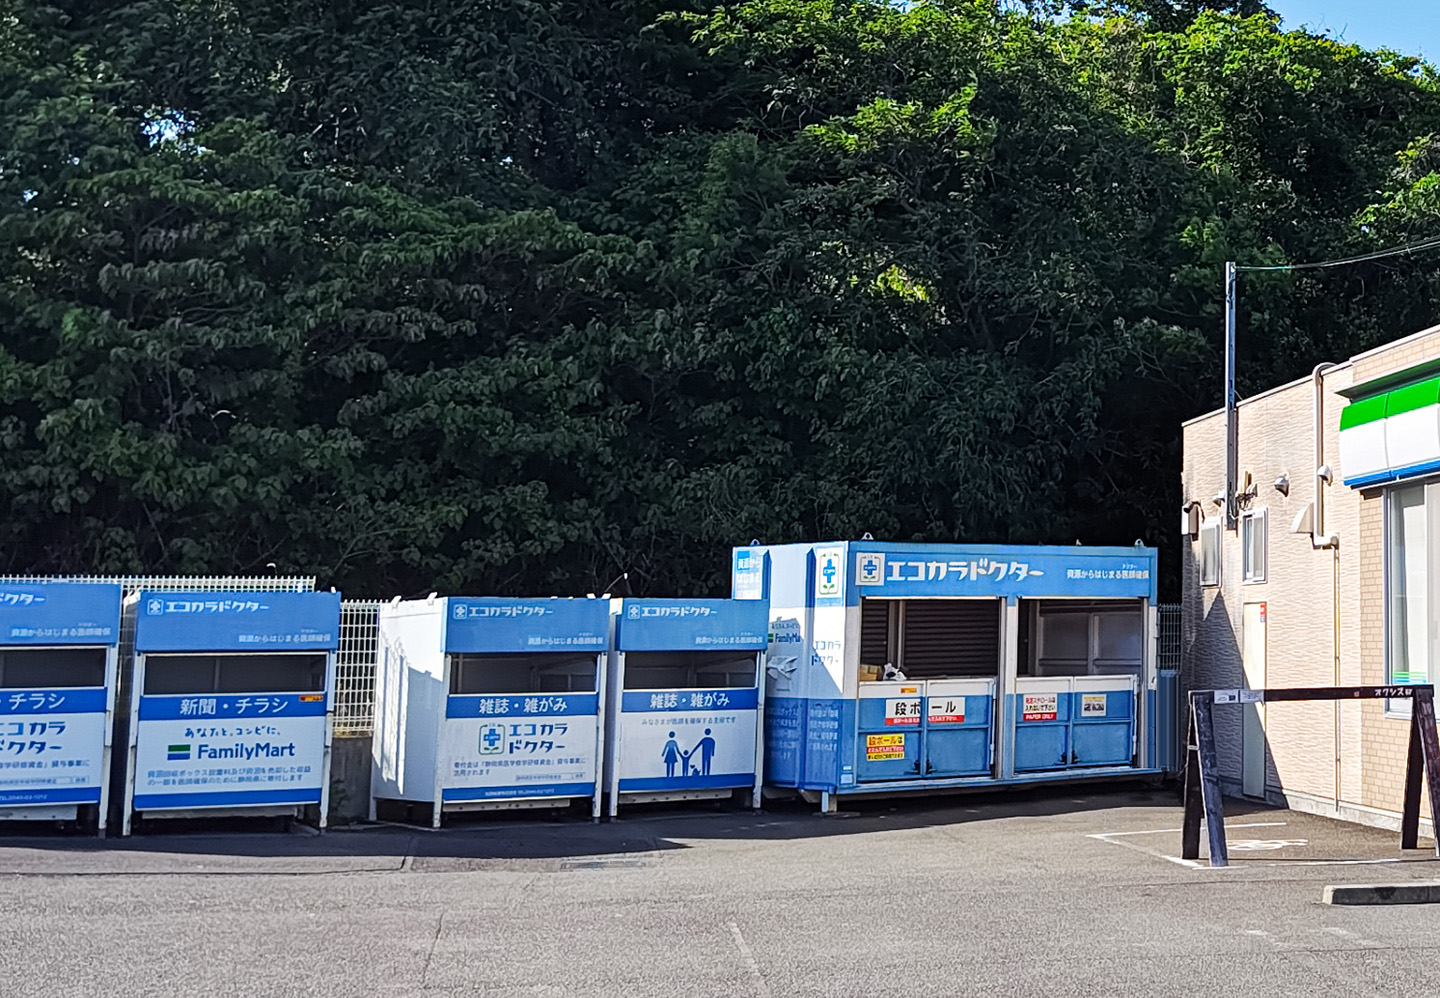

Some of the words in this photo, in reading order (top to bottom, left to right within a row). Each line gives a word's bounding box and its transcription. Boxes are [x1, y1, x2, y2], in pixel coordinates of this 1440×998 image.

[886, 557, 1045, 581] エコカラドクター
[0, 593, 46, 605] クター
[165, 600, 270, 613] エコカラドクター
[468, 605, 554, 617] エコカラドクター
[641, 606, 718, 617] エコカラドクター
[179, 698, 288, 716] 新聞・チラシ
[478, 697, 568, 714] 雑誌・雑がみ
[649, 691, 730, 709] 雑誌・雑がみ
[508, 722, 568, 737] エコカラ
[197, 742, 296, 760] FamilyMart
[508, 739, 566, 754] ドクター
